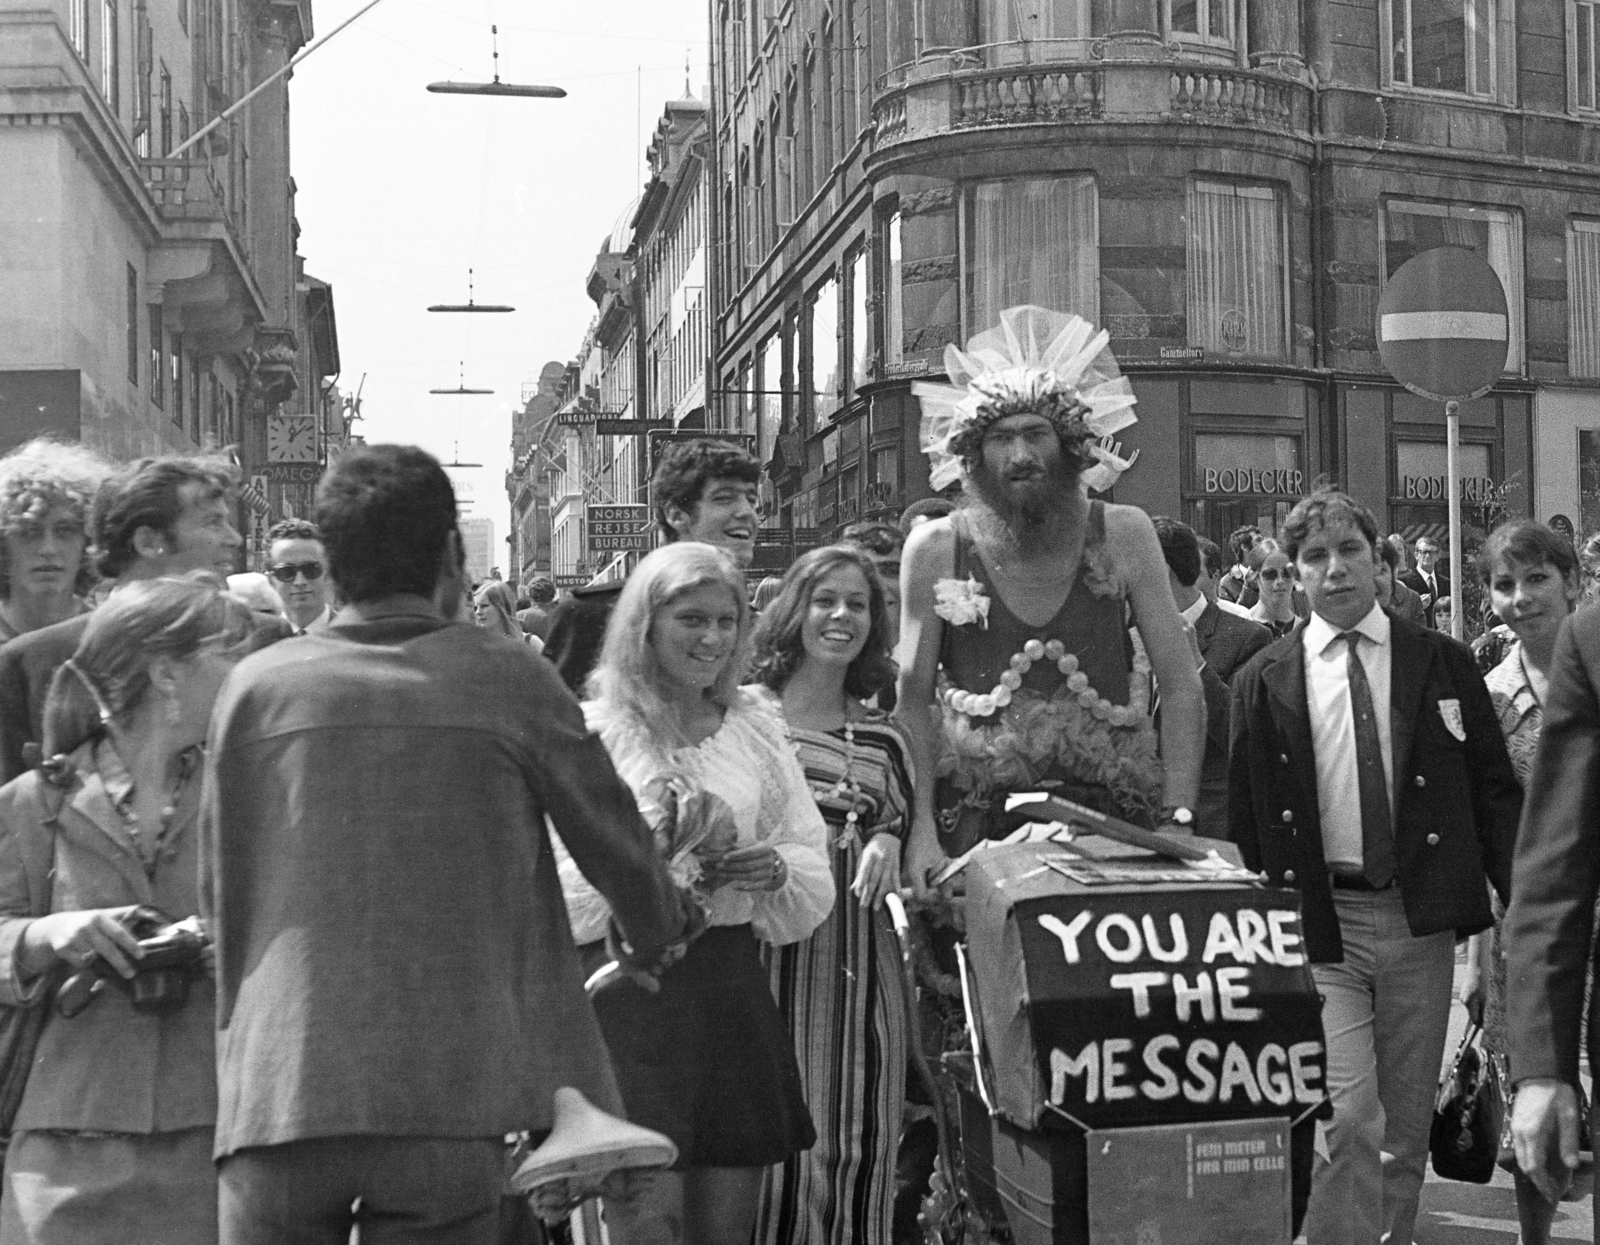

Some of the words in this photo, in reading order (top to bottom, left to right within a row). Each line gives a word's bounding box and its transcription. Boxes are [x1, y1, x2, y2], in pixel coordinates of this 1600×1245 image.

[1205, 467, 1303, 495] BODECKER
[595, 509, 640, 519] NORSK
[595, 523, 641, 533] REJSE
[595, 538, 642, 548] BUREAU
[1037, 909, 1190, 965] YOU
[1202, 908, 1306, 966] ARE
[1109, 966, 1264, 1022] THE
[1049, 1034, 1326, 1106] MESSAGE
